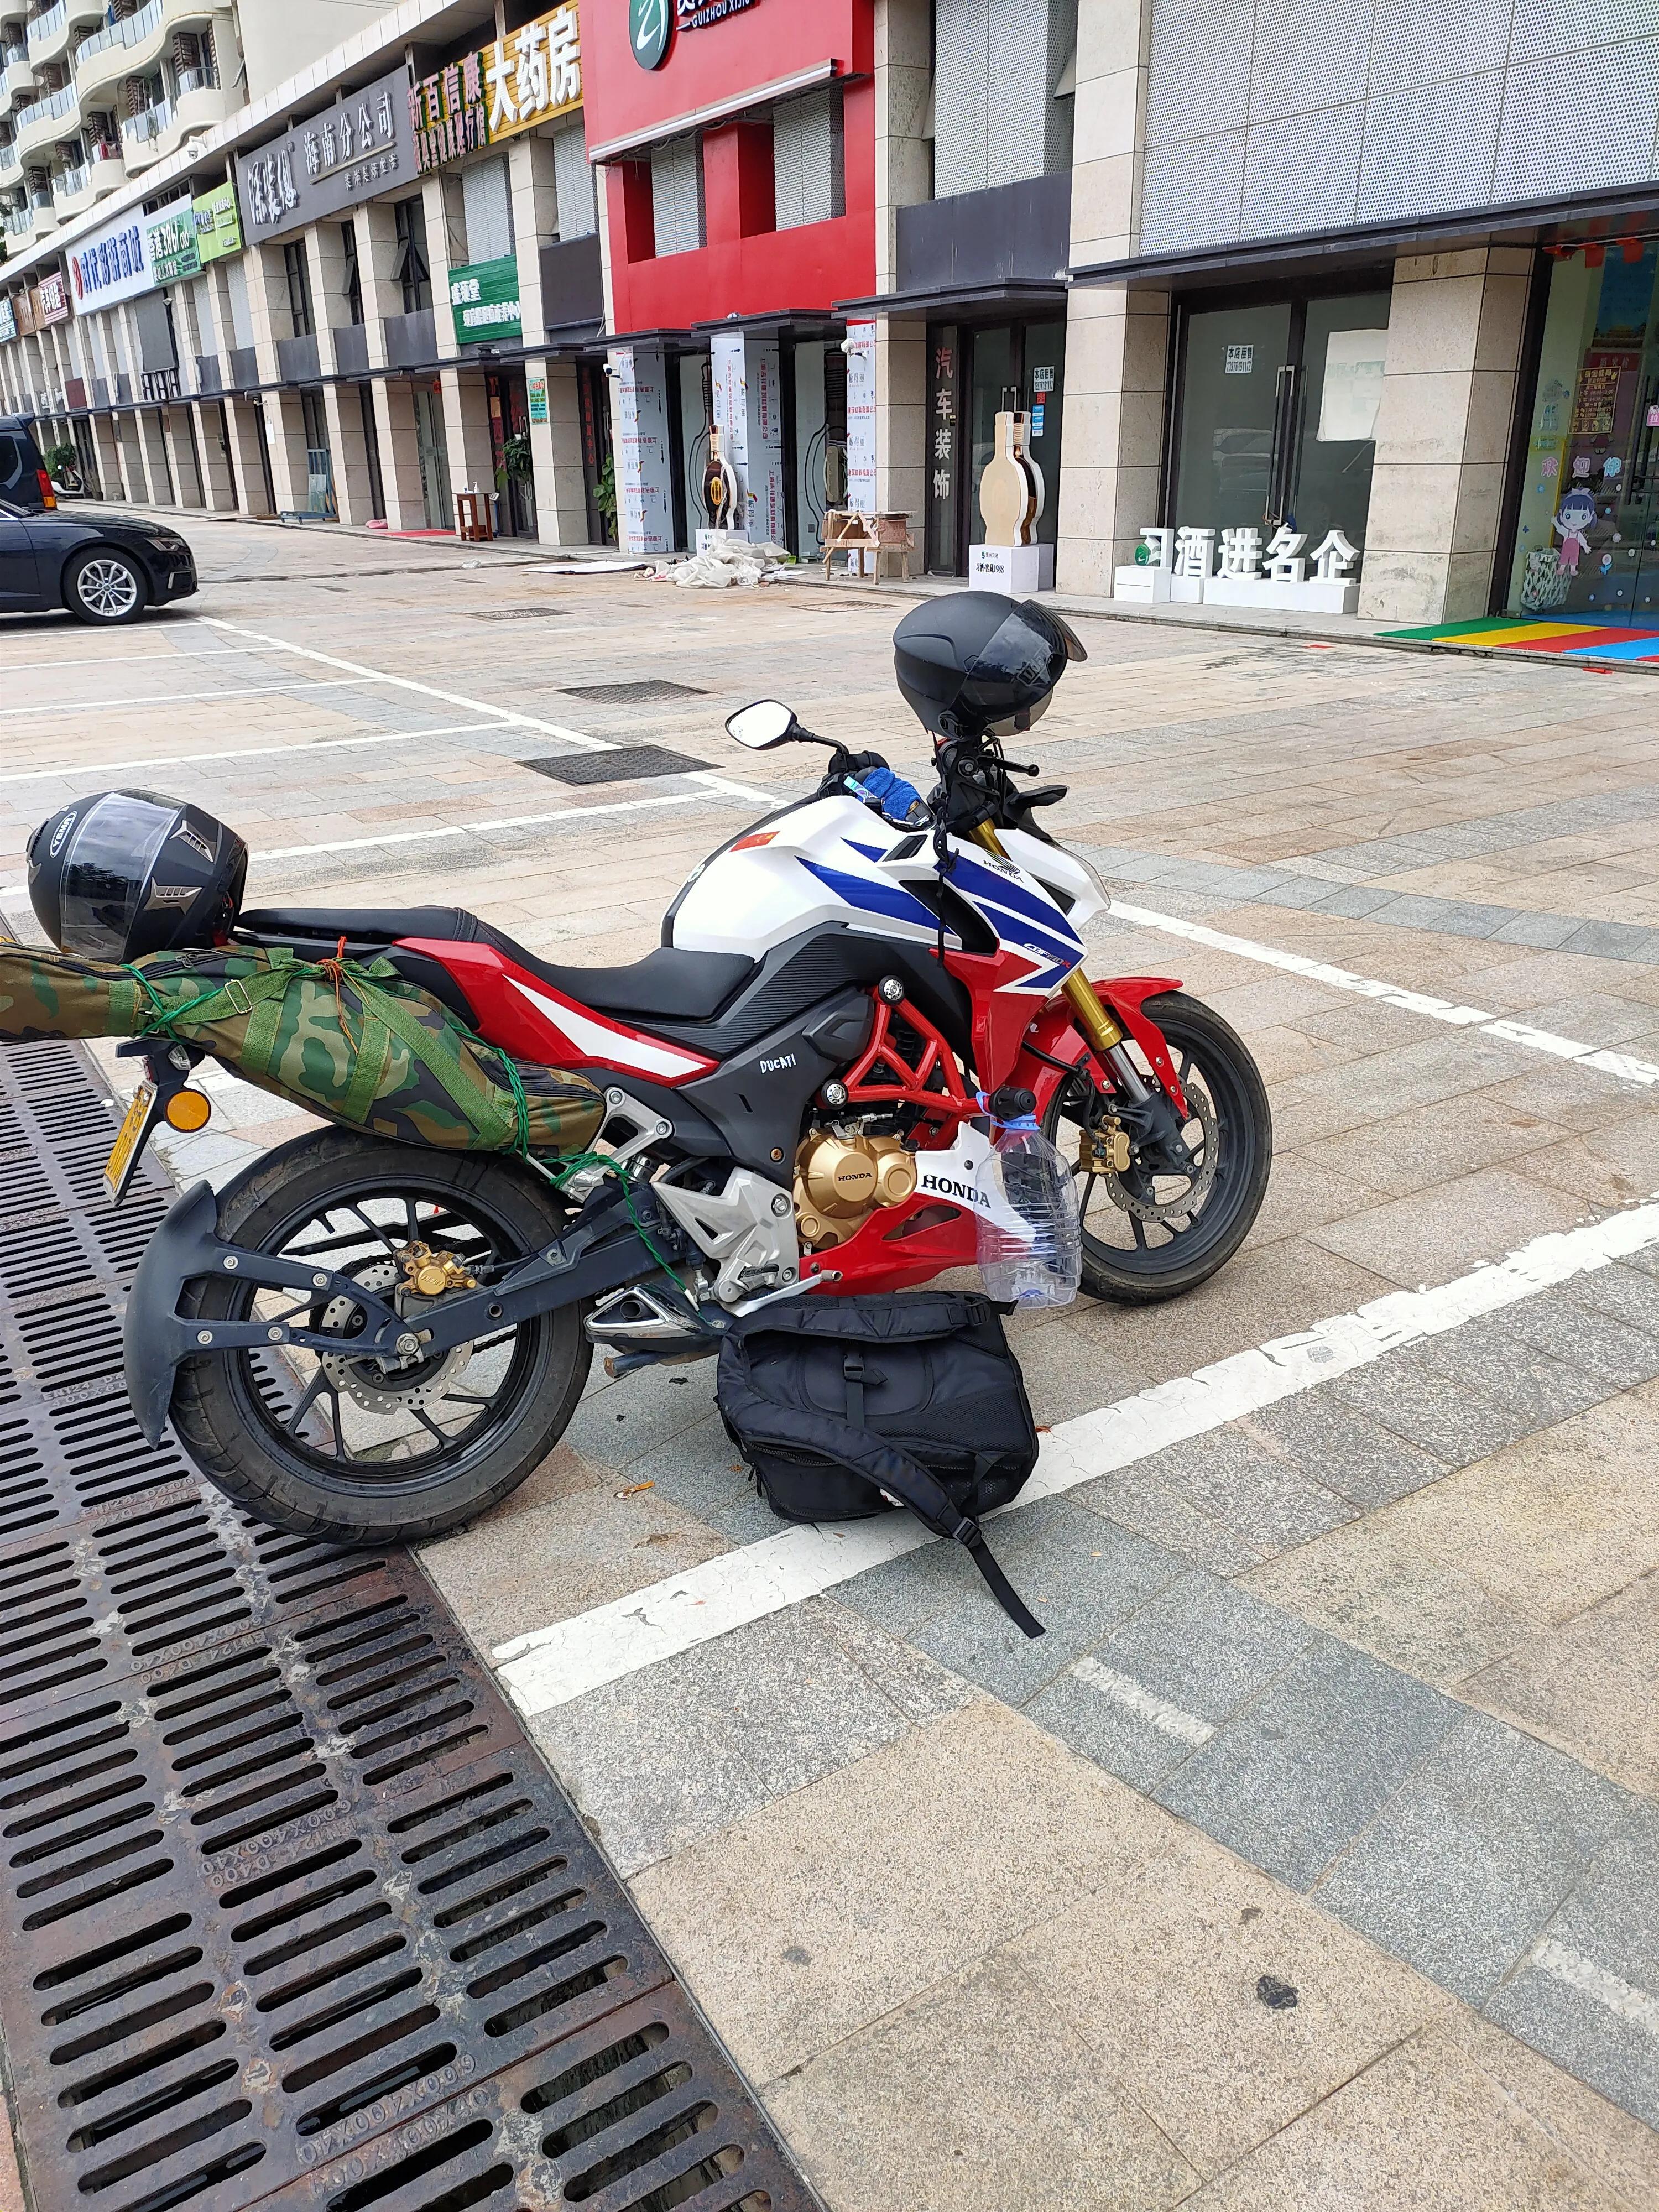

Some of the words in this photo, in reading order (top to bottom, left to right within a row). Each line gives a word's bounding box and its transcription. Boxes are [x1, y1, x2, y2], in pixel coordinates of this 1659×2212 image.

[692, 3, 727, 28] GUIZHOU
[486, 6, 581, 132] 大药房
[304, 91, 394, 175] 海南分公司
[933, 347, 953, 500] 汽车装饰
[1541, 455, 1622, 478] 欢迎你
[1135, 521, 1361, 586] 习酒进名企
[53, 817, 72, 848] YEMA
[982, 859, 1025, 883] HONDA
[1022, 943, 1071, 968] CBF190R
[760, 1053, 796, 1074] DUCATI
[837, 1172, 873, 1182] HONDA
[922, 1174, 992, 1209] HONDA
[140, 1658, 192, 1683] D400
[296, 2053, 475, 2164] 600X400X40
